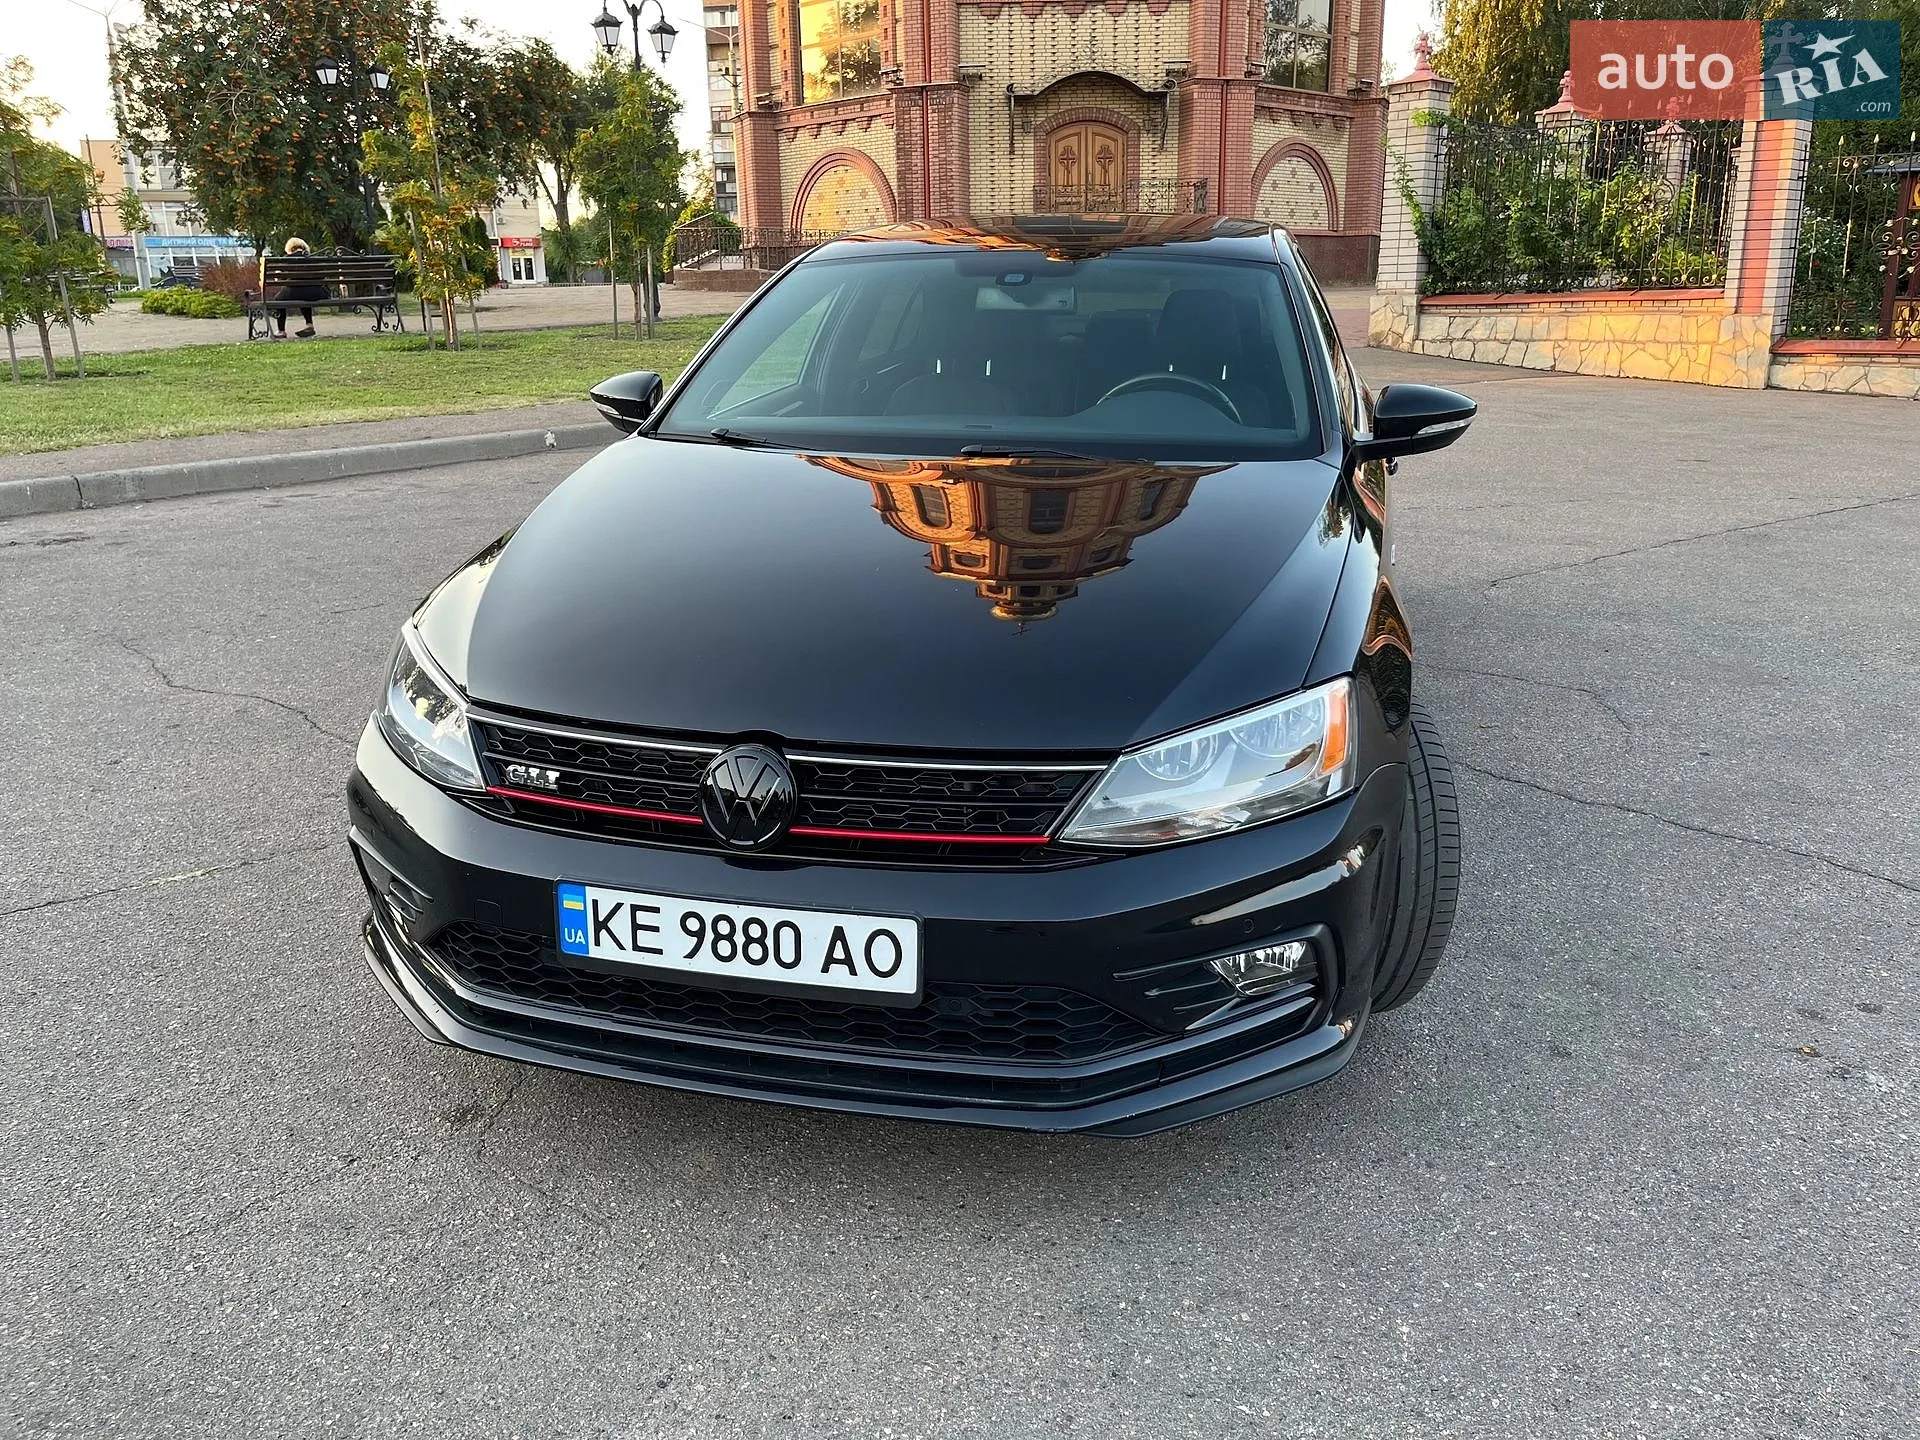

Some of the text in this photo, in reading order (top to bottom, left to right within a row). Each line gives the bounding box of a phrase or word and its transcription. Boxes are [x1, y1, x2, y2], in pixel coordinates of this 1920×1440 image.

[505, 764, 561, 790] GLI
[564, 927, 587, 945] UA
[591, 898, 903, 979] KE 9880 AO
